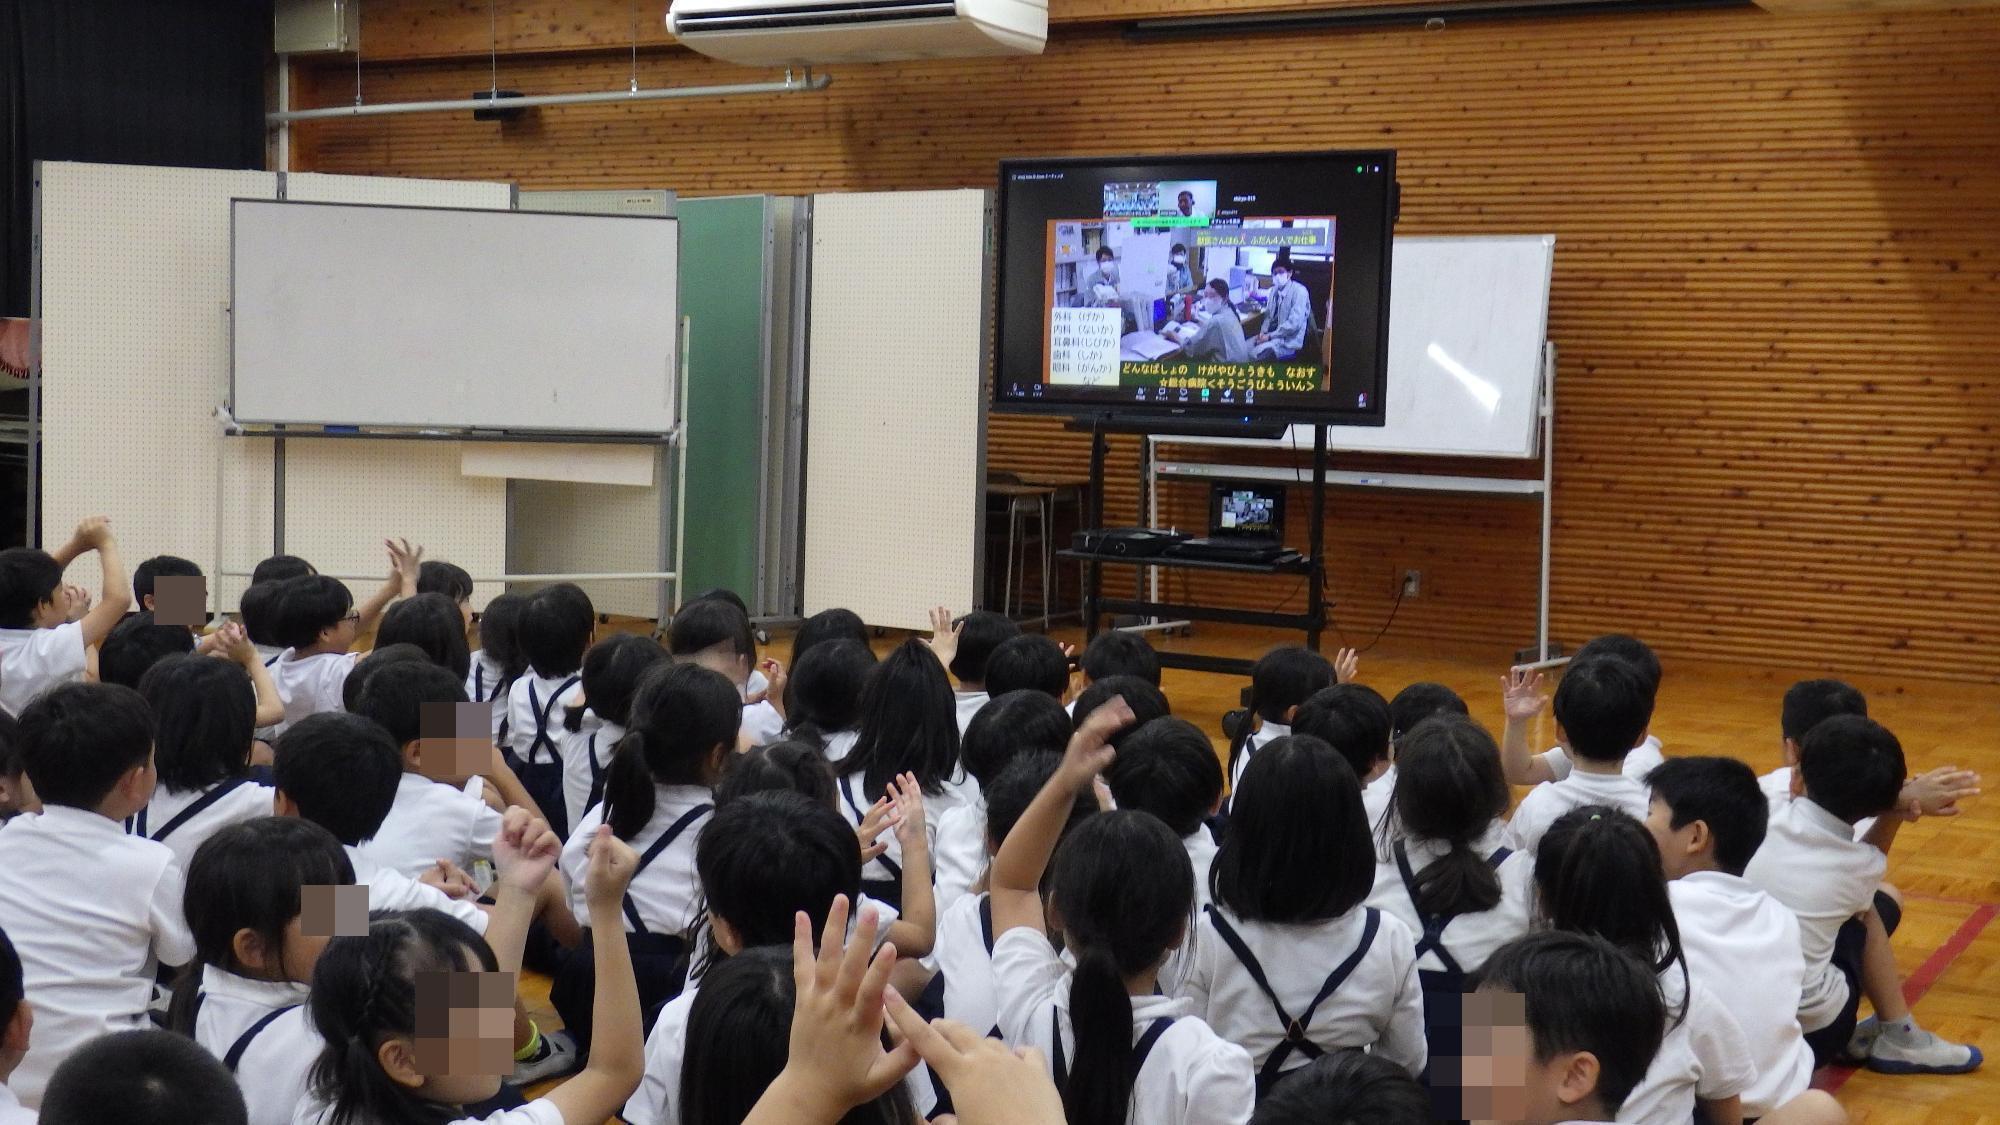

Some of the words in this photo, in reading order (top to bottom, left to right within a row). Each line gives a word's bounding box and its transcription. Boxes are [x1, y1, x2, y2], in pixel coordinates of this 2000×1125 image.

[1122, 362, 1187, 375] どんなばしょの
[1197, 364, 1275, 378] けがやびょうきも
[1286, 366, 1316, 378] なおす
